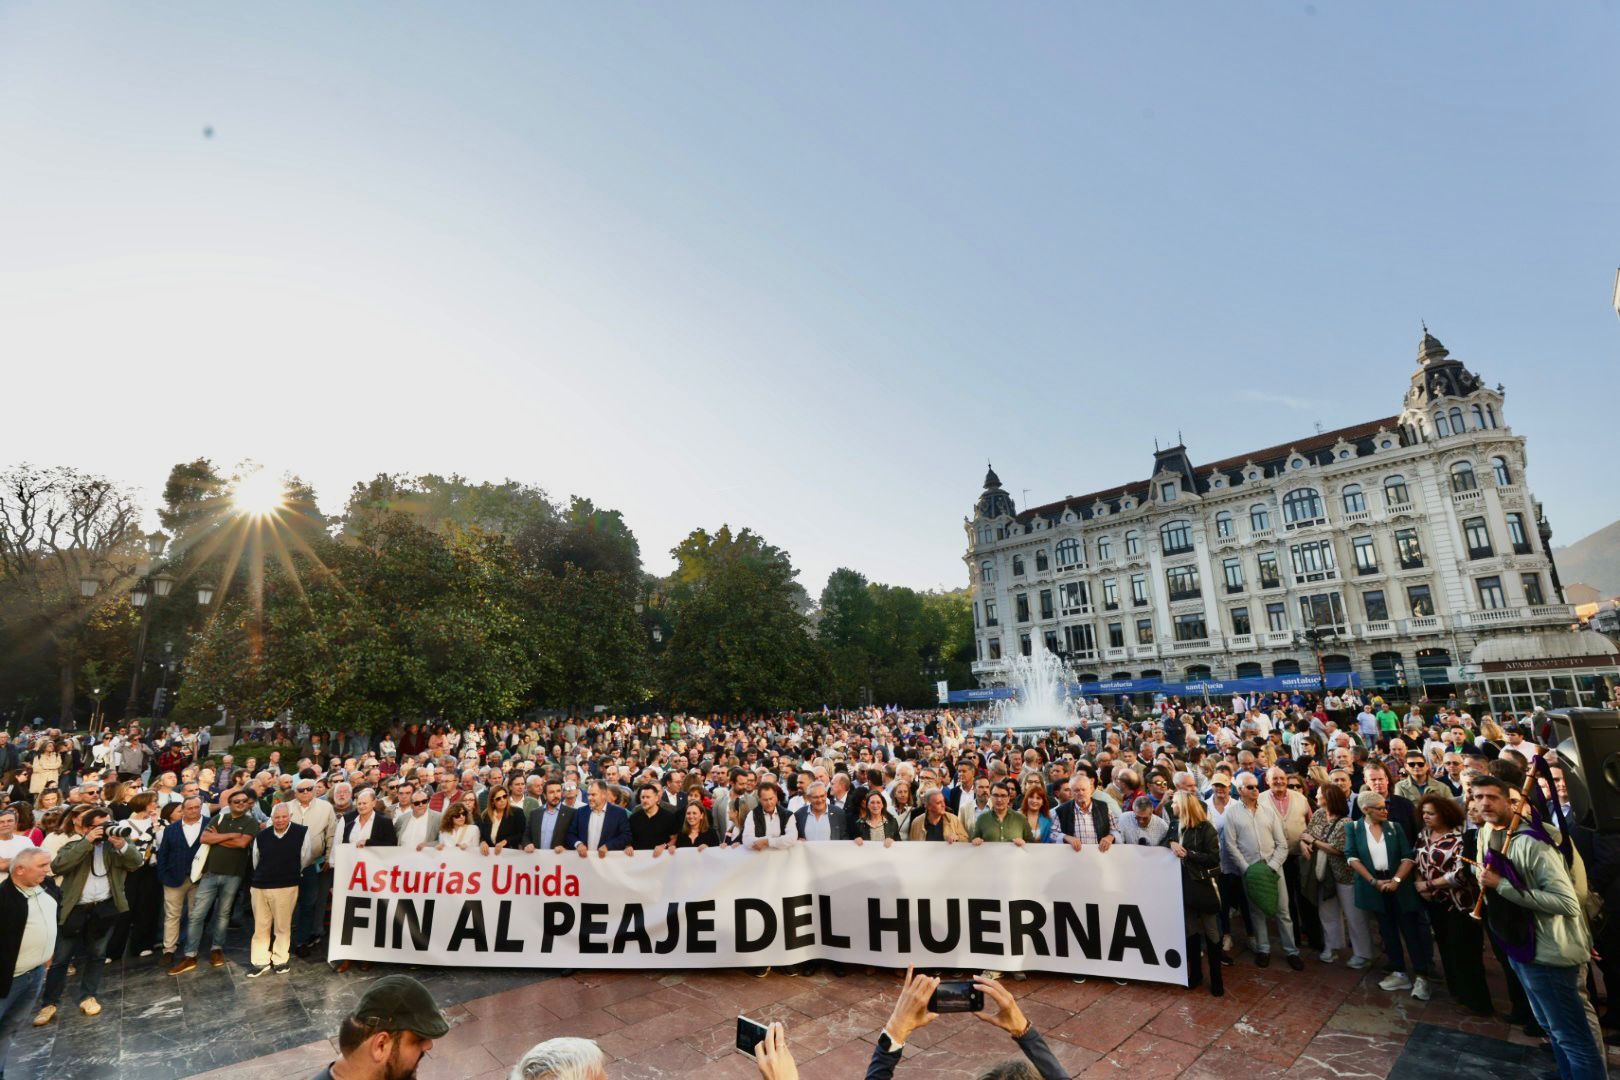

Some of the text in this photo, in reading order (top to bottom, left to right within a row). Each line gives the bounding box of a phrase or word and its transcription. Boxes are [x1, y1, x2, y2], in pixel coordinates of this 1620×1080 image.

[347, 861, 580, 897] Asturias Unida
[340, 894, 1182, 969] FIN AL PEAJE DEL HUERNA.
